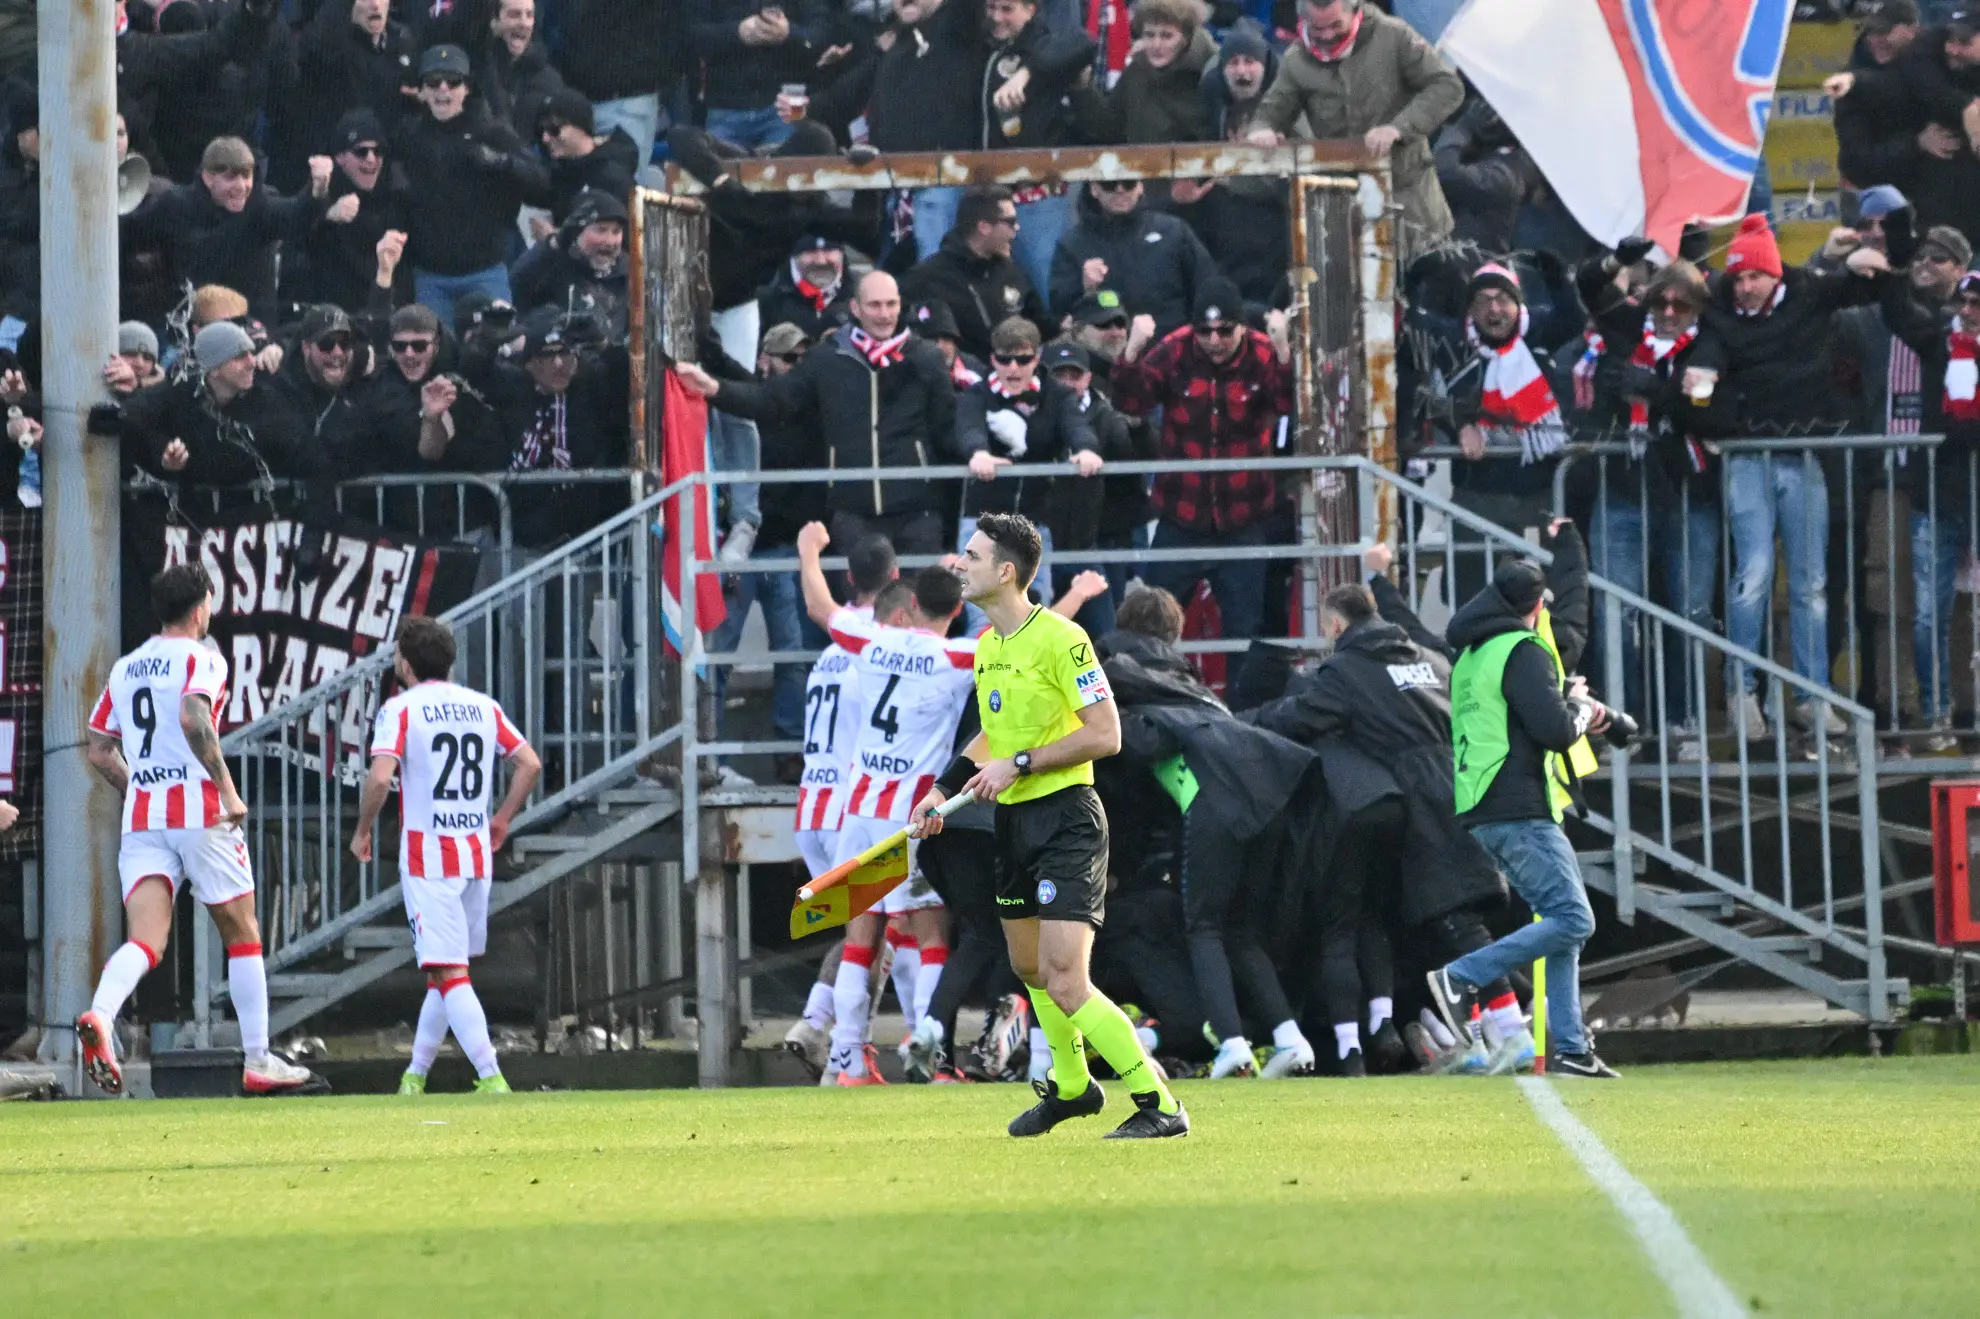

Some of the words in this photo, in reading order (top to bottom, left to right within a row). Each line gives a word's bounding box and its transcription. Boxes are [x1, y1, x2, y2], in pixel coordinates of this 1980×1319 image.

[125, 657, 171, 680] MORRA
[870, 646, 934, 676] CARRARO
[132, 687, 156, 758] 9
[422, 703, 483, 723] CAFERRI
[807, 684, 841, 754] 27
[871, 673, 901, 744] 4
[431, 732, 484, 801] 28
[805, 768, 838, 784] ARDI
[433, 812, 484, 829] NARDI
